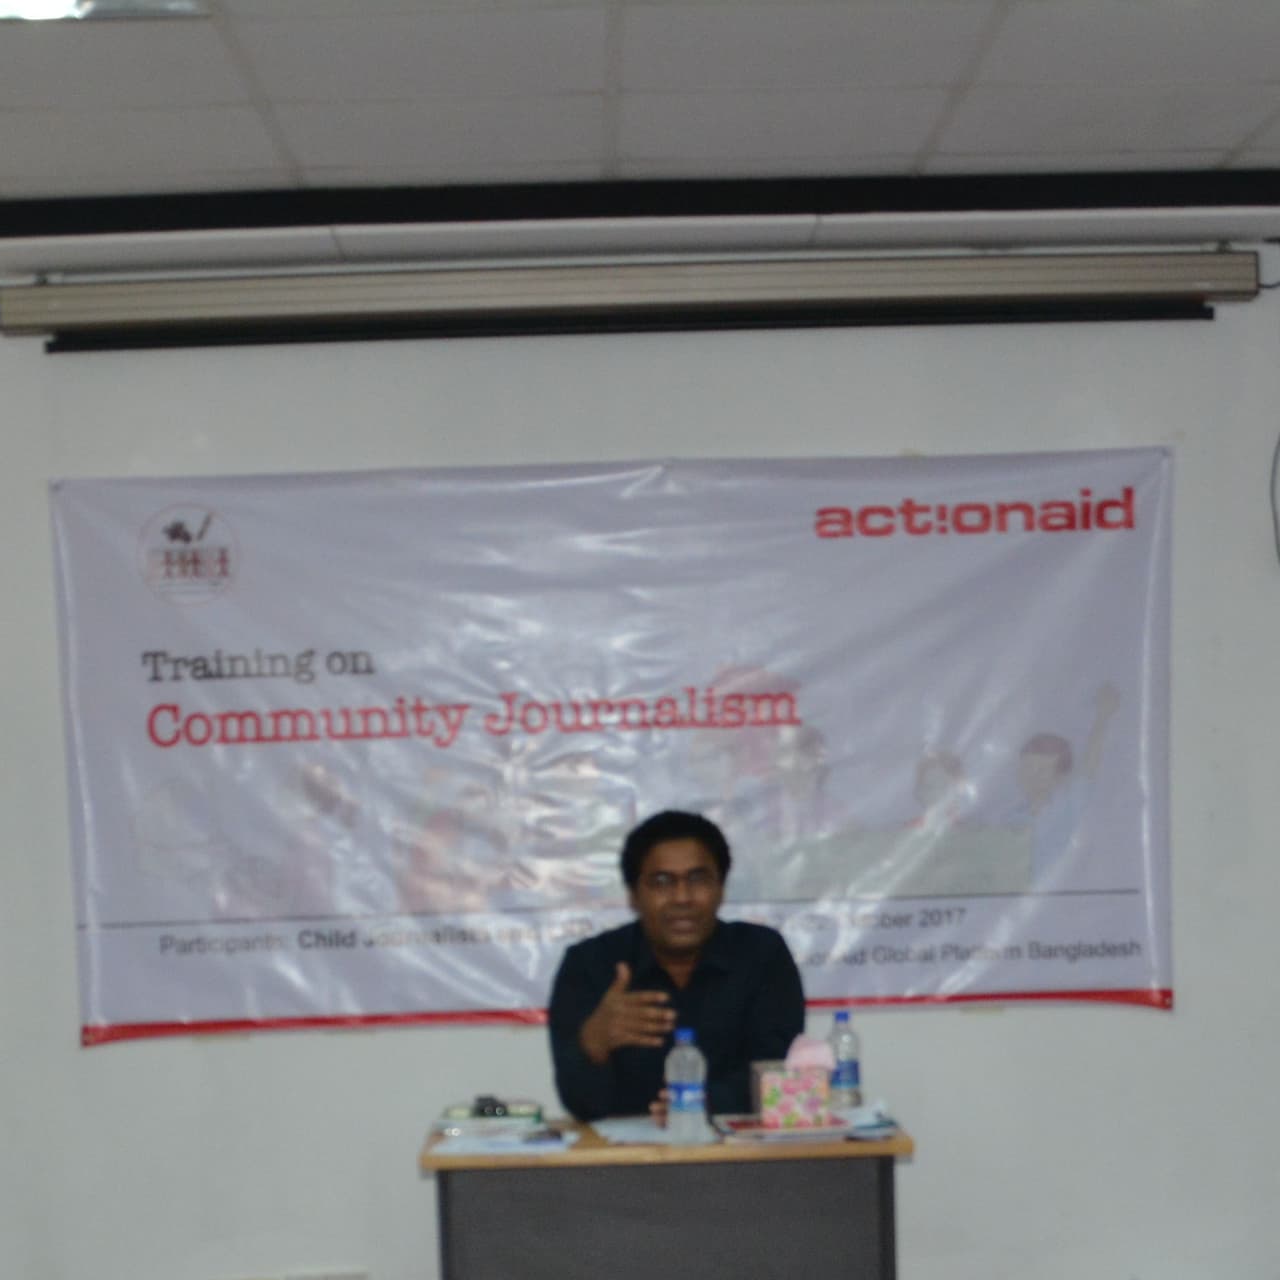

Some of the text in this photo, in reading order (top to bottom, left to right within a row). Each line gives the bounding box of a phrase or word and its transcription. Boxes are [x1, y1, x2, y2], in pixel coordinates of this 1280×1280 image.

[142, 649, 376, 684] Training on
[146, 686, 802, 749] Community Journalism
[918, 906, 966, 930] 2017
[297, 926, 358, 951] Child
[1026, 938, 1142, 966] Bangladesh
